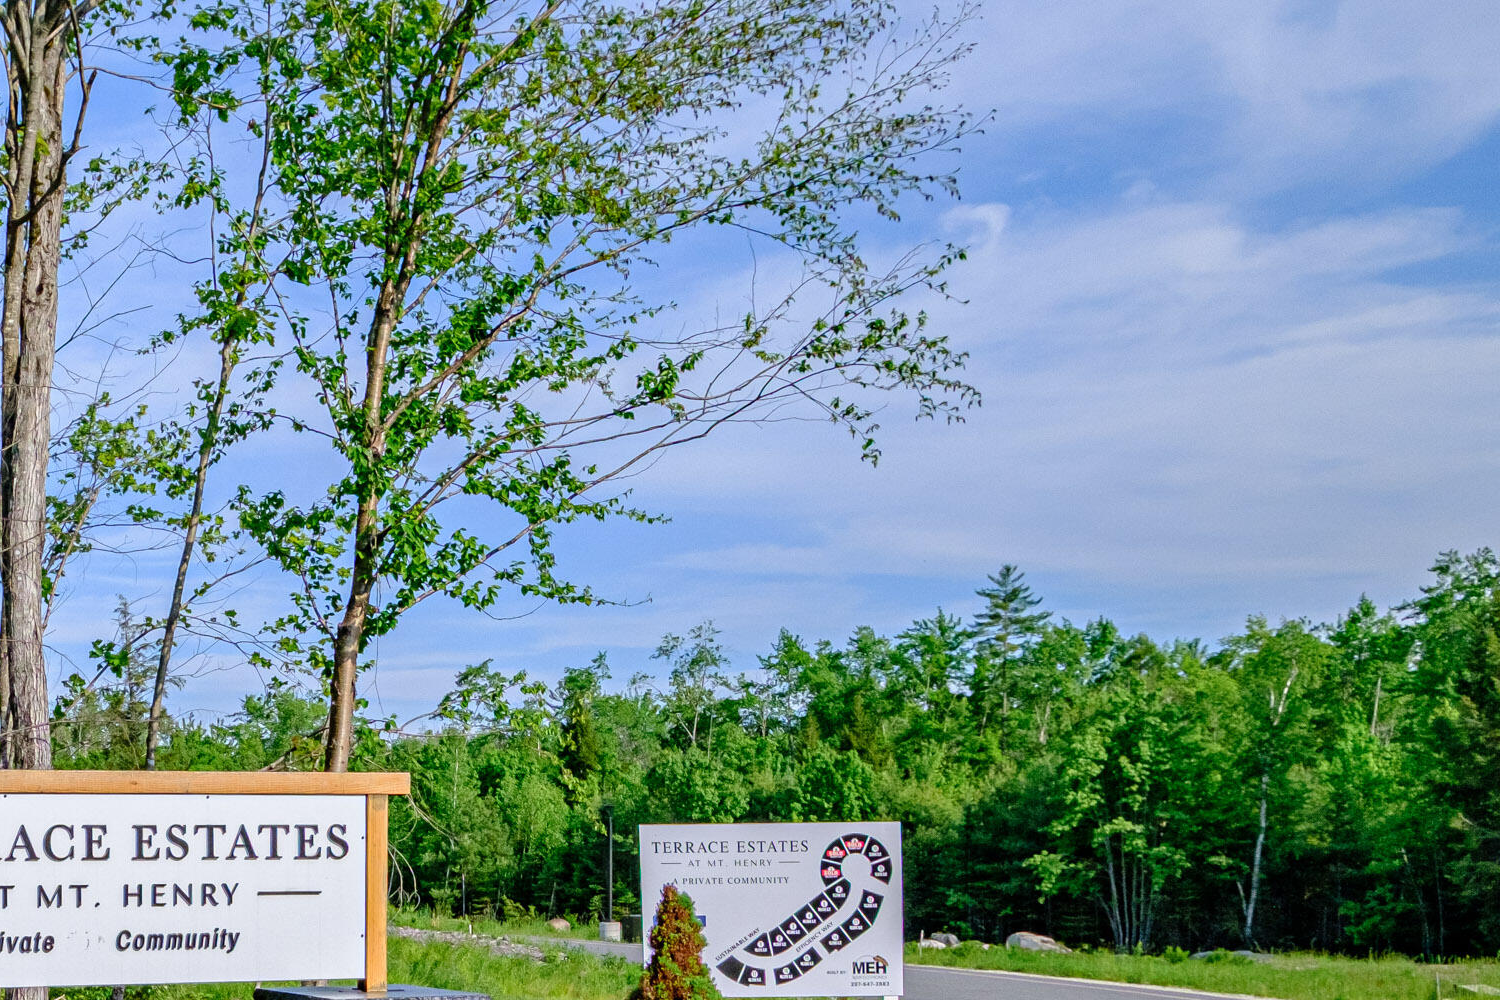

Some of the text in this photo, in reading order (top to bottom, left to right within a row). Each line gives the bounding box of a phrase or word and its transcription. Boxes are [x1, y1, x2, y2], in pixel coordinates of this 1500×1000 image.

[131, 823, 350, 861] ESTATES
[651, 839, 809, 854] TERRACE ESTATES
[688, 858, 773, 867] AT MT. HENRY
[682, 877, 725, 885] PRIVATE
[727, 876, 790, 885] COMMUNITY
[37, 884, 101, 909] MT.
[122, 883, 240, 908] HENRY
[115, 927, 241, 954] Community
[715, 935, 748, 961] SUSTAINABLE
[795, 932, 822, 953] EFFICIENCY
[852, 961, 887, 974] MEH
